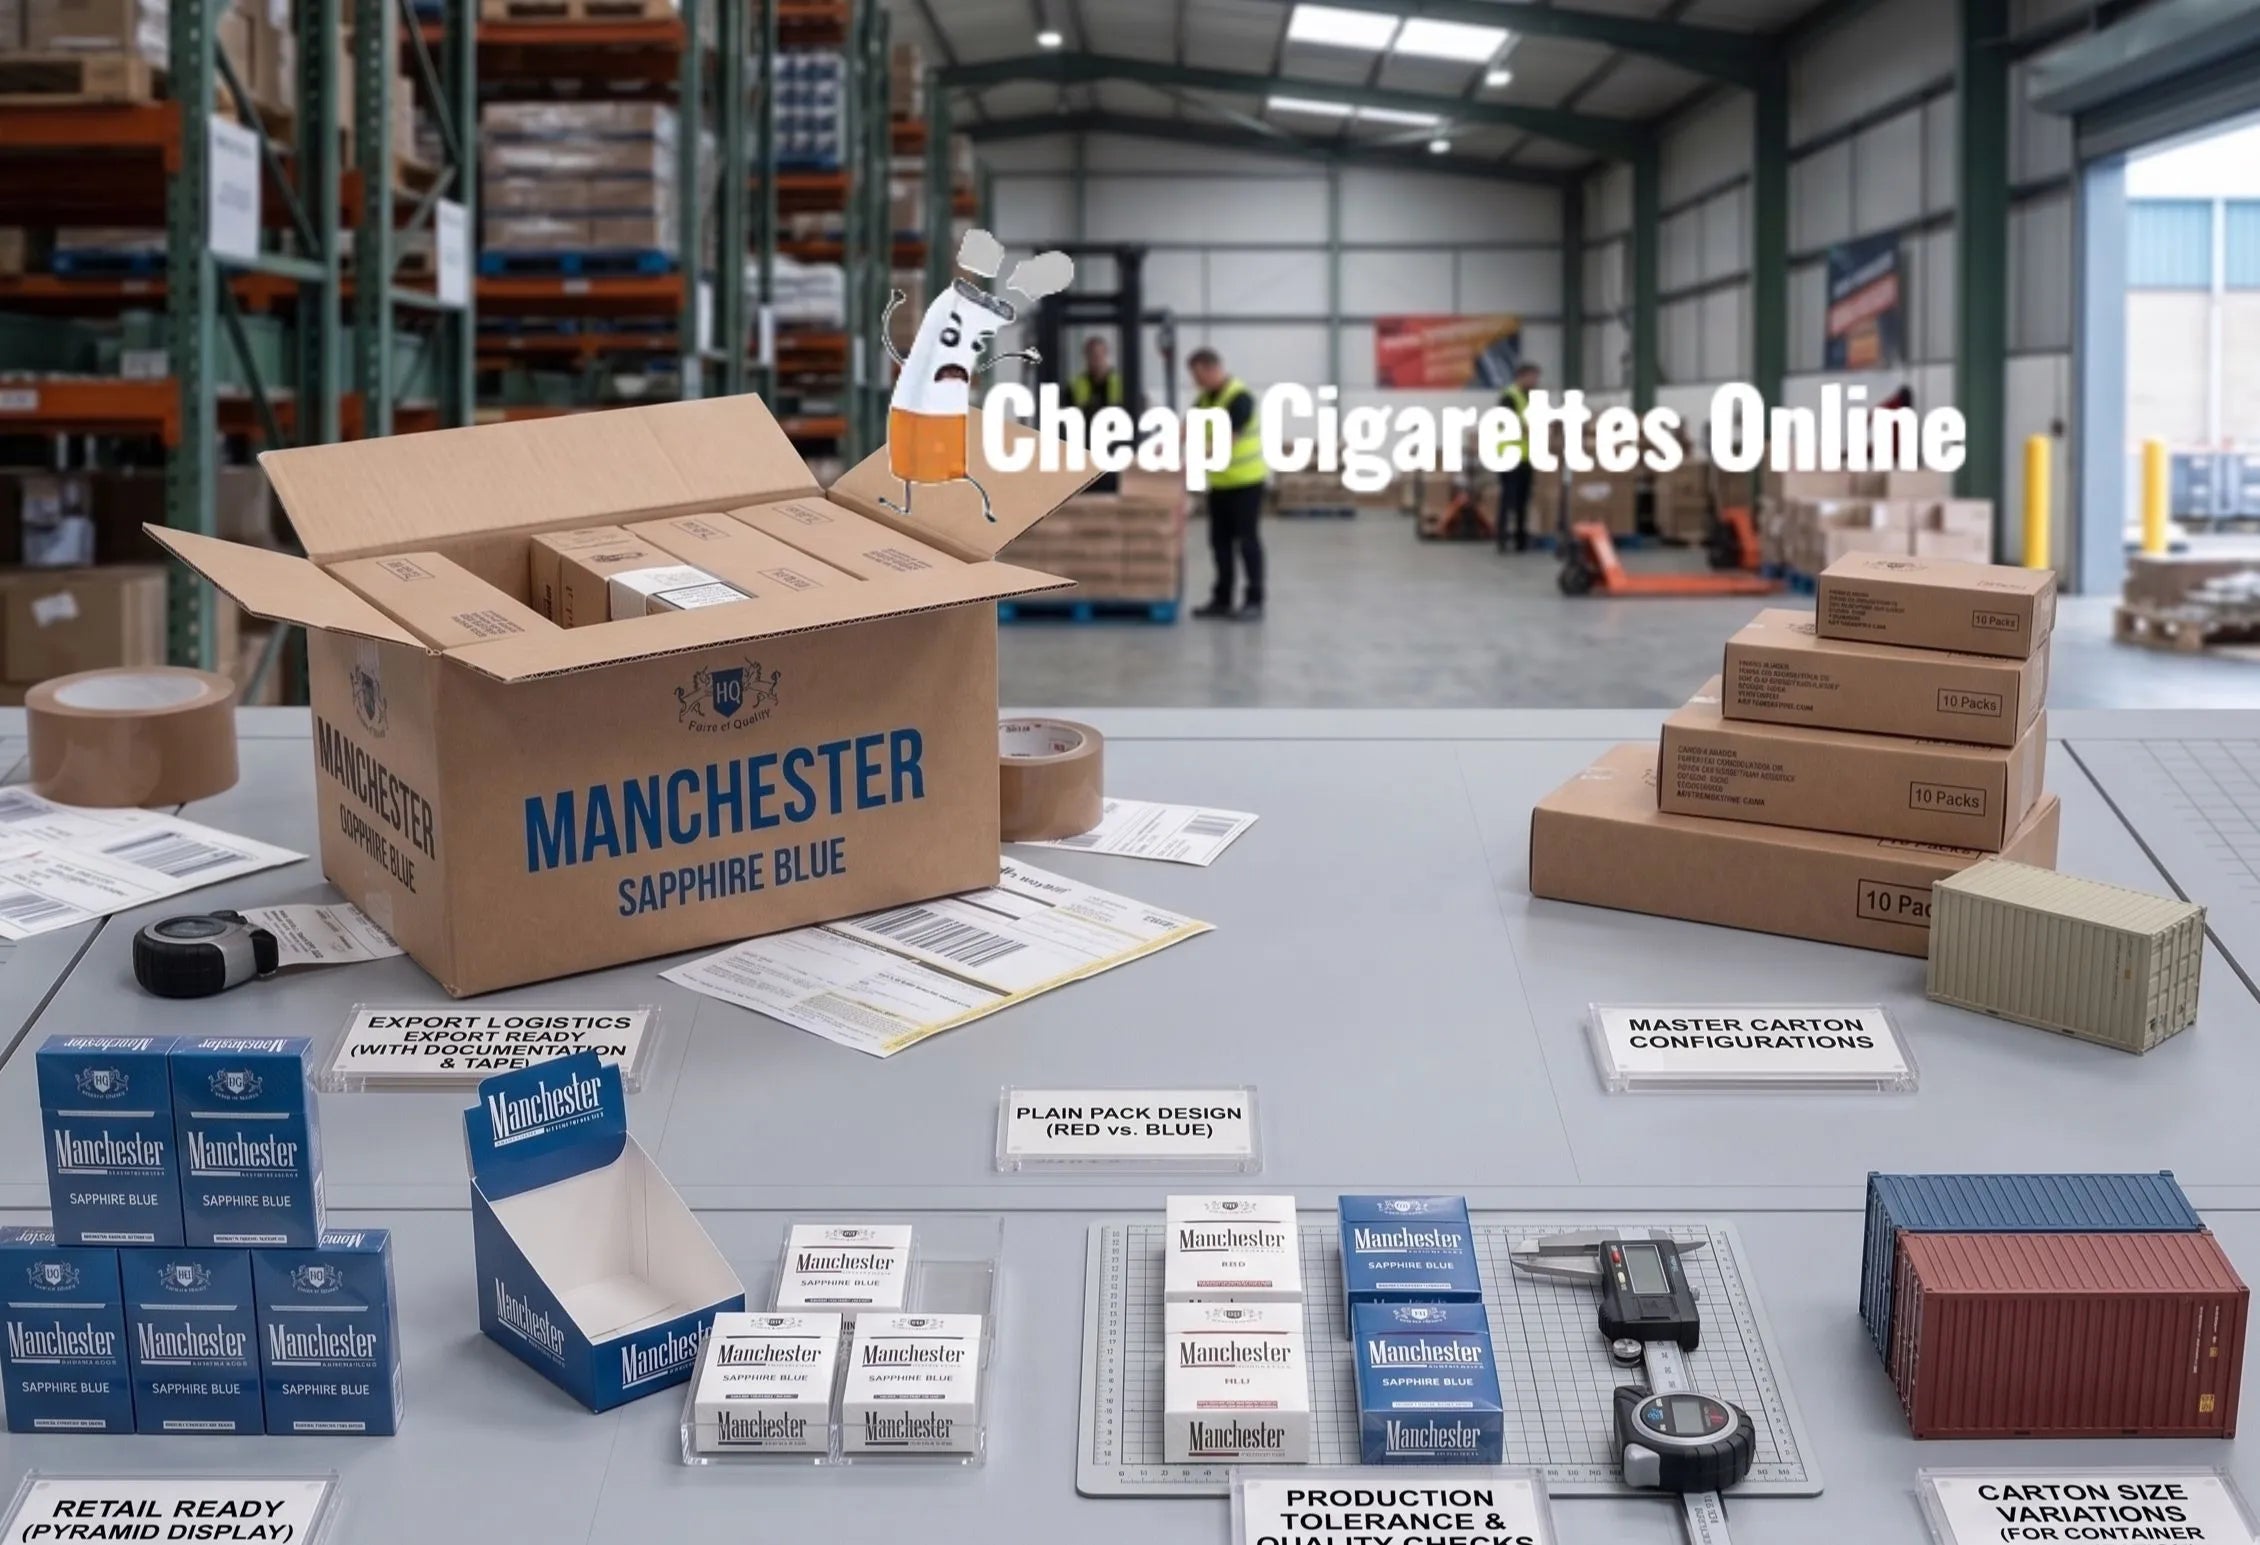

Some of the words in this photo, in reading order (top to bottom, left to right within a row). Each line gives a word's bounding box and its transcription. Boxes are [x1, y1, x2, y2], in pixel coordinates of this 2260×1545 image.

[1976, 614, 1987, 625] 10
[1989, 616, 2016, 628] Packs
[716, 680, 740, 704] HQ
[1943, 694, 1958, 708] 10
[1961, 695, 1997, 712] Packs
[317, 716, 436, 861] MANCHESTER
[524, 727, 925, 873] MANCHESTER
[1915, 788, 1932, 804] 10
[1936, 791, 1980, 809] Packs
[389, 842, 417, 895] BLUE
[618, 852, 765, 917] SAPPHIRE
[774, 836, 847, 886] BLUE
[1866, 889, 1891, 912] 10
[368, 1016, 482, 1029] EXPORT
[487, 1016, 631, 1029] LOGISTICS
[1629, 1019, 1743, 1031] MASTER
[1750, 1019, 1864, 1031] CARTON
[403, 1031, 501, 1042] EXPORT
[505, 1031, 586, 1042] READY
[1629, 1036, 1875, 1049] CONFIGURATIONS
[350, 1044, 417, 1057] (WITH
[424, 1044, 627, 1056] DOCUMENTATION
[440, 1058, 456, 1069] &
[488, 1072, 602, 1140] Manchester
[1016, 1107, 1083, 1119] PLAIN
[1090, 1107, 1151, 1119] PACK
[1158, 1107, 1242, 1119] DESIGN
[1046, 1123, 1100, 1138] (RED
[1107, 1125, 1137, 1136] vs.
[1146, 1123, 1213, 1138] BLUE)
[54, 1129, 165, 1167] Manchester
[187, 1131, 298, 1169] Manchester
[69, 1193, 126, 1206] SAPPHIRE
[129, 1193, 159, 1206] BLUE
[203, 1194, 259, 1207] SAPPHIRE
[262, 1194, 292, 1208] BLUE
[1180, 1228, 1285, 1249] Manchester
[1354, 1227, 1462, 1249] Manchester
[796, 1253, 894, 1272] Manchester
[495, 1277, 565, 1356] Manchester
[6, 1321, 116, 1357] Manchester
[136, 1322, 247, 1359] Manchester
[268, 1323, 377, 1360] Manchester
[717, 1344, 821, 1364] Manchester
[862, 1344, 965, 1365] Manchester
[1180, 1340, 1291, 1365] Manchester
[1369, 1339, 1482, 1365] Manchester
[22, 1382, 78, 1393] SAPPHIRE
[81, 1382, 110, 1393] BLUE
[152, 1383, 208, 1394] SAPPHIRE
[211, 1383, 241, 1394] BLUE
[282, 1384, 337, 1395] SAPPHIRE
[341, 1384, 370, 1395] BLUE
[1382, 1378, 1440, 1386] SAPPHIRE
[1443, 1378, 1474, 1386] BLUE
[718, 1410, 807, 1441] Manchester
[864, 1410, 953, 1441] Manchester
[1189, 1420, 1285, 1451] Manchester
[1386, 1420, 1481, 1451] Manchester
[1286, 1490, 1494, 1506] PRODUCTION
[1978, 1484, 2110, 1500] CARTON
[2119, 1484, 2188, 1500] SIZE
[53, 1500, 163, 1517] RETAIL
[173, 1500, 286, 1517] READY
[1996, 1506, 2187, 1522] VARIATIONS
[1280, 1513, 1474, 1530] TOLERANCE
[1485, 1513, 1507, 1530] &
[22, 1524, 160, 1543] (PYRAMID
[167, 1524, 293, 1543] DISPLAY)
[2000, 1527, 2057, 1543] (FOR
[2064, 1527, 2205, 1540] CONTAINER
